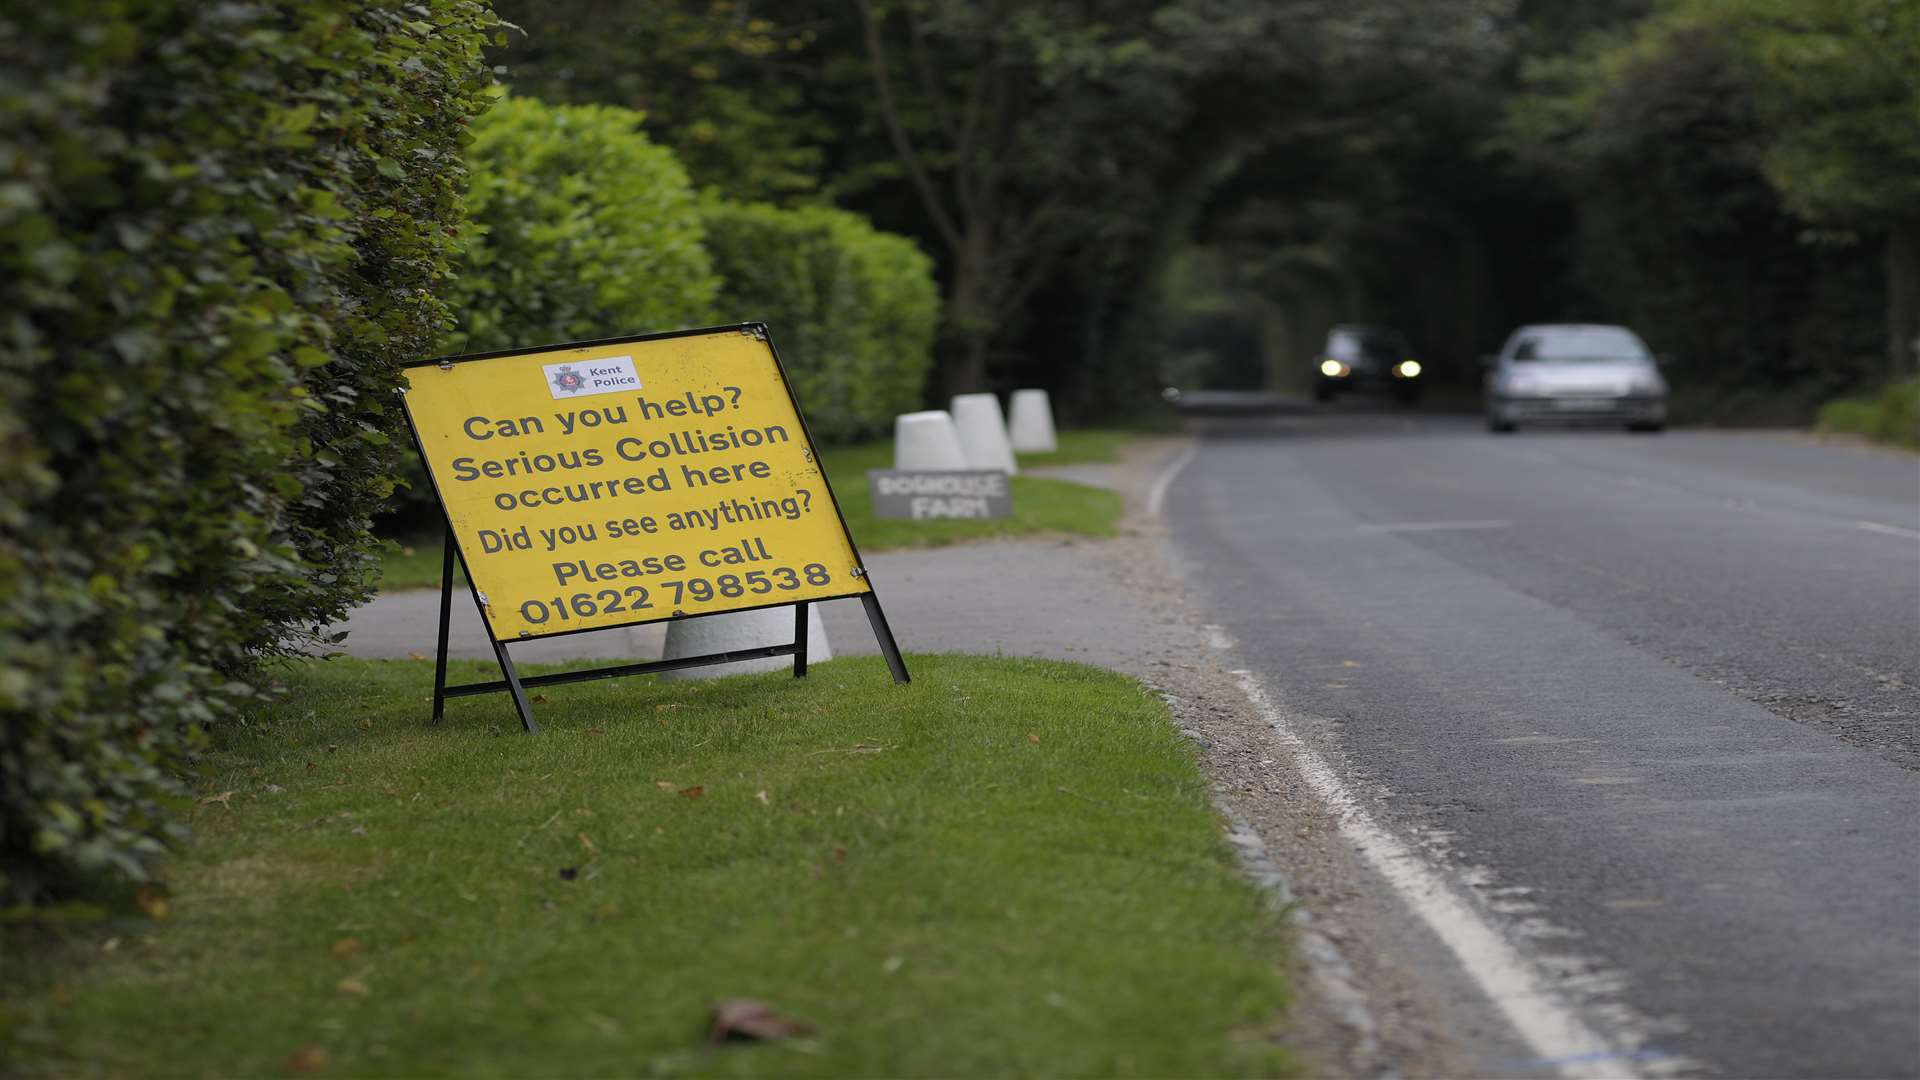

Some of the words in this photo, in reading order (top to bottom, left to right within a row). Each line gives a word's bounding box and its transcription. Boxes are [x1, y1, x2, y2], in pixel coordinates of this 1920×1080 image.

[590, 366, 623, 376] Kent
[593, 376, 635, 387] Police
[464, 416, 545, 441] Can
[555, 405, 628, 435] you
[637, 386, 743, 421] help?
[452, 449, 604, 481] Serious
[616, 425, 789, 462] Collision
[494, 468, 671, 511] occurred
[682, 461, 771, 488] here
[910, 497, 990, 519] FARM
[478, 528, 532, 554] Did
[540, 524, 597, 551] you
[608, 517, 657, 538] see
[667, 490, 813, 530] anything?
[553, 551, 687, 586] Please
[698, 538, 773, 567] call
[520, 585, 654, 624] 01622
[660, 564, 832, 605] 798538
